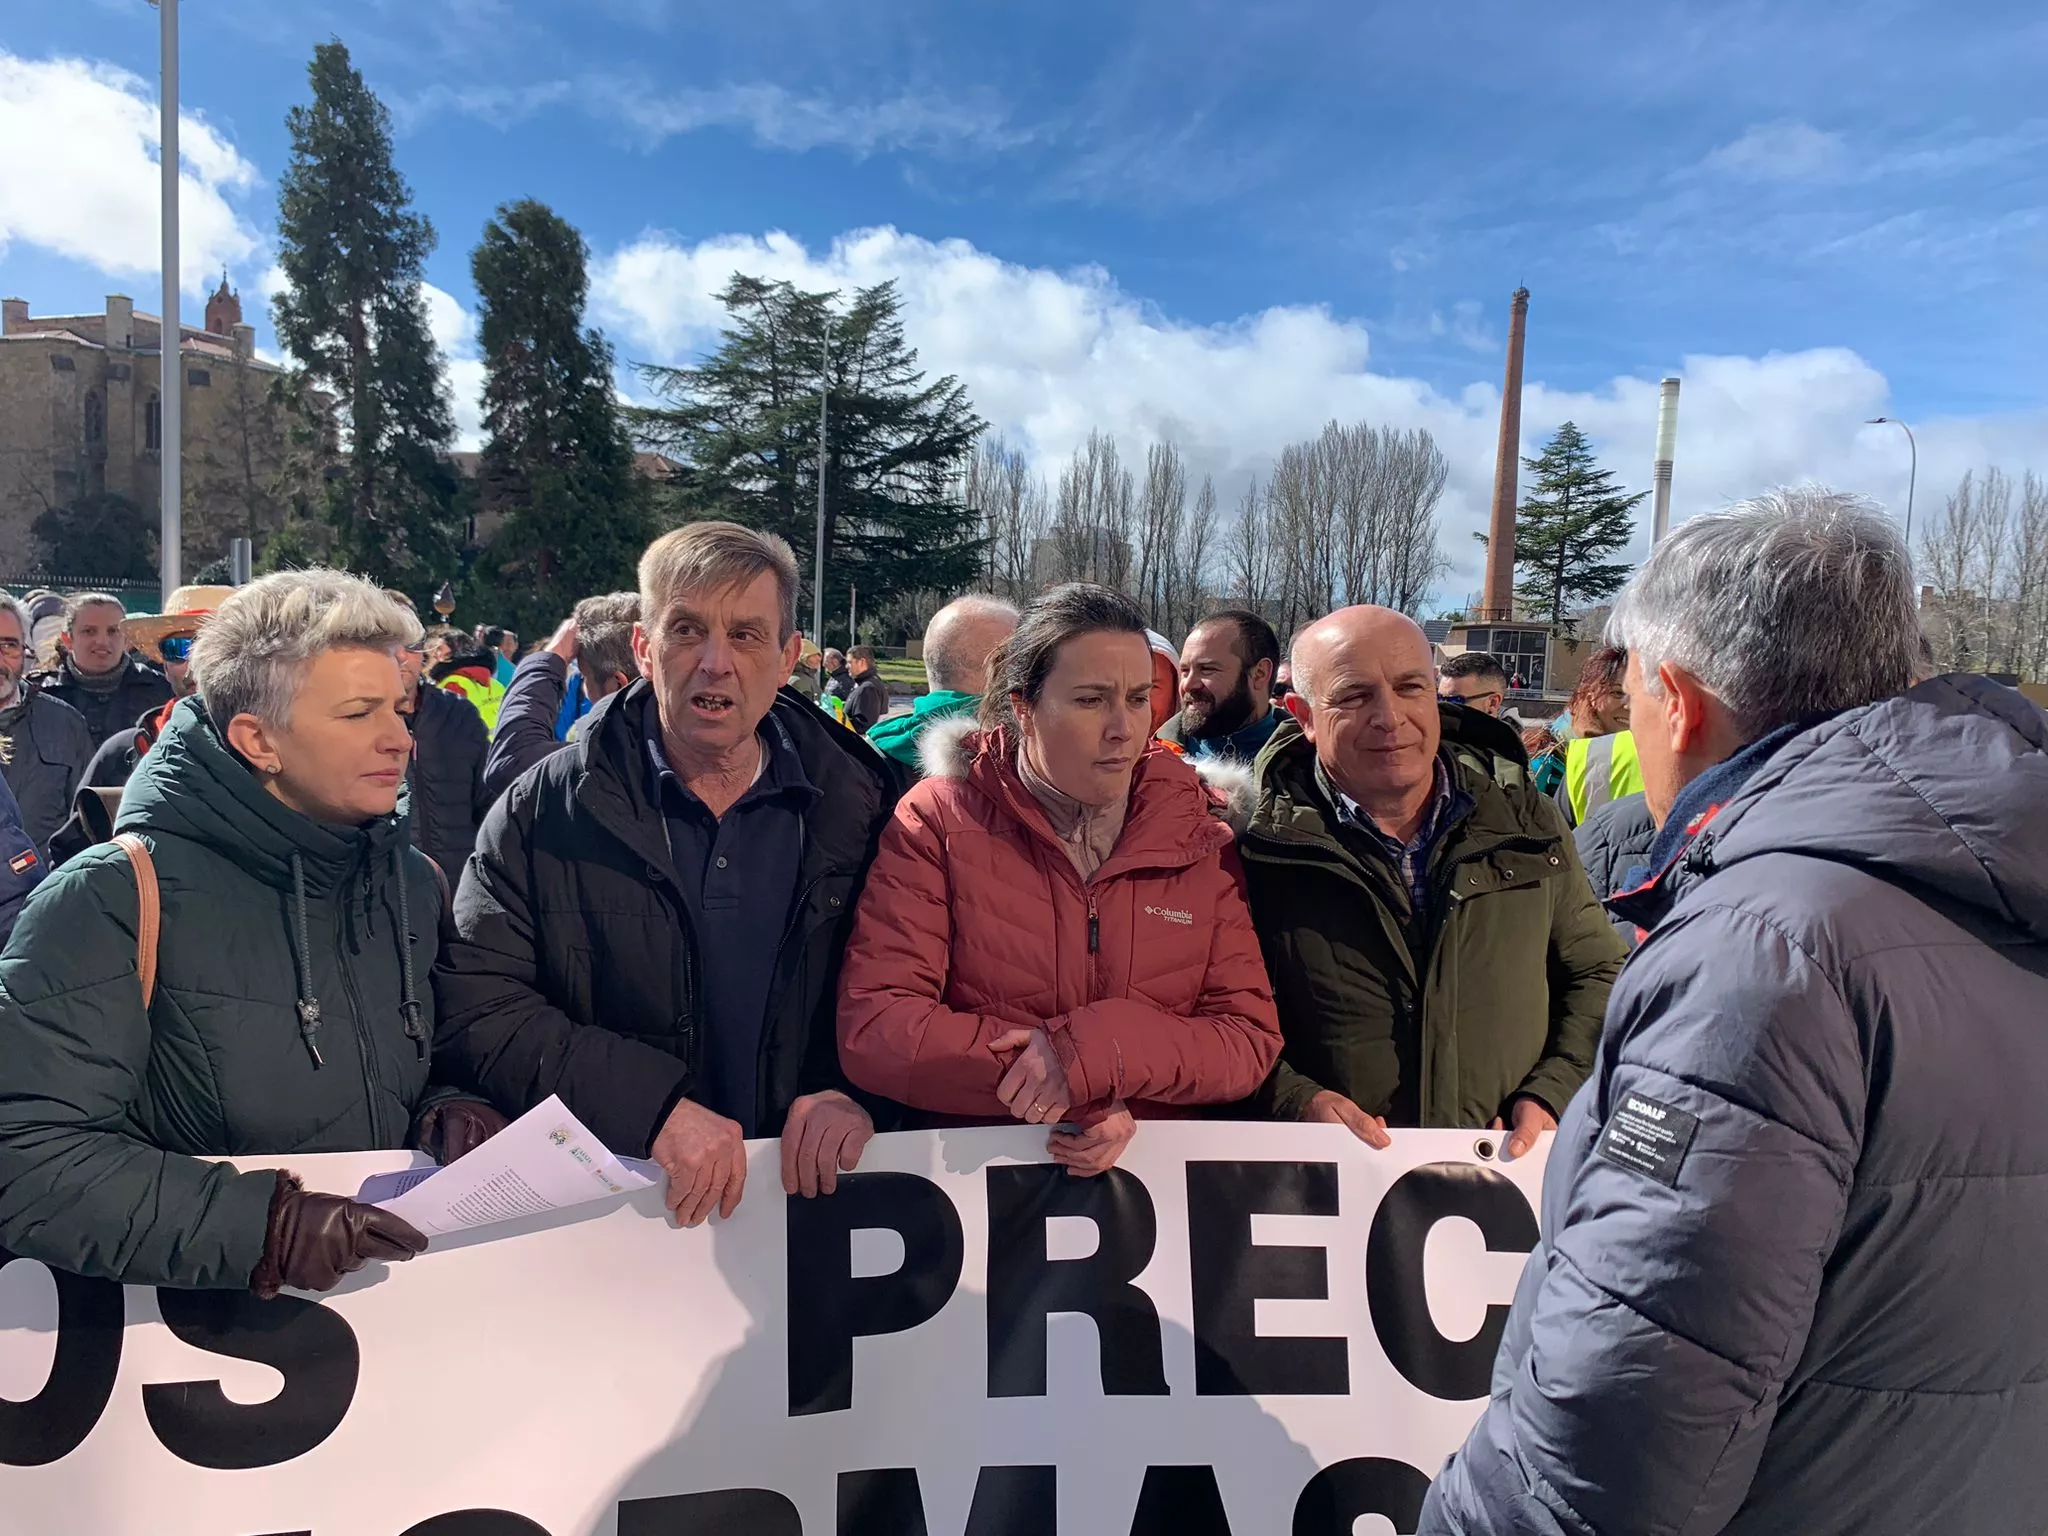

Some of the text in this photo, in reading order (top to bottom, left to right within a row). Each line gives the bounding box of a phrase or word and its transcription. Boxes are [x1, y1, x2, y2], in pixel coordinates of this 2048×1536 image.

[1153, 907, 1192, 919] Columbia
[1164, 916, 1192, 925] TITANIUM
[1627, 1098, 1667, 1120] ECOALF
